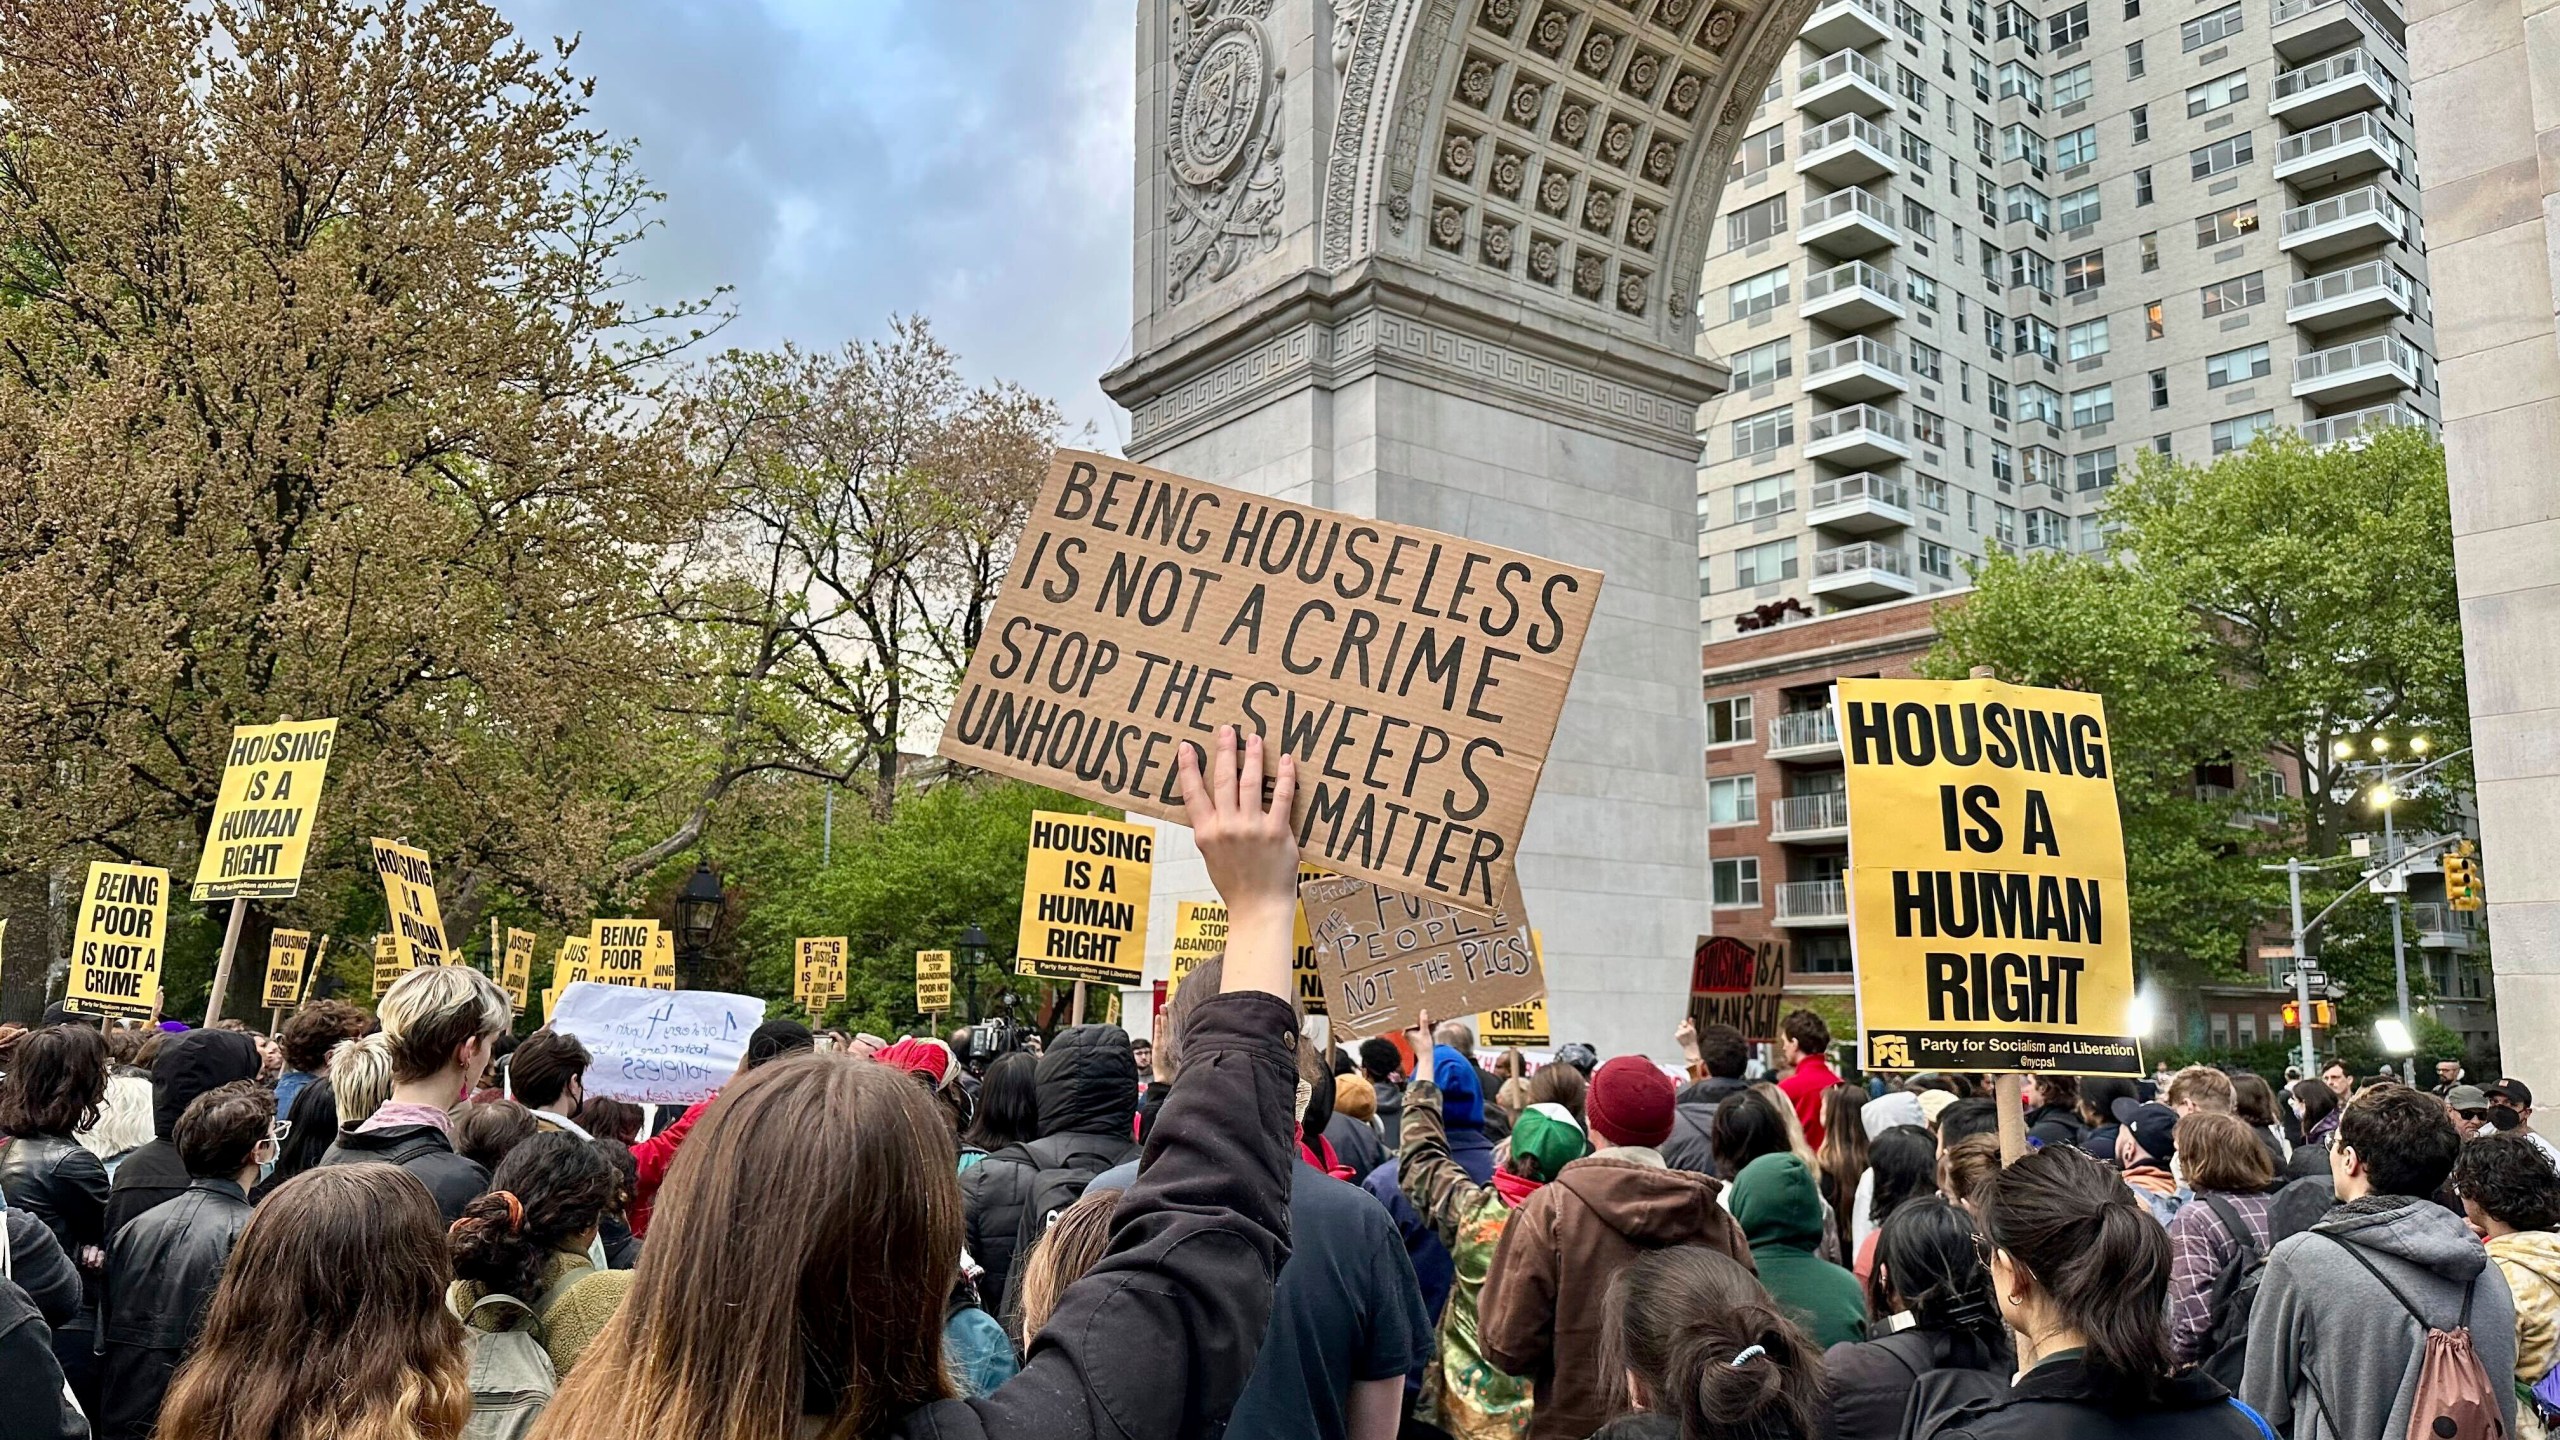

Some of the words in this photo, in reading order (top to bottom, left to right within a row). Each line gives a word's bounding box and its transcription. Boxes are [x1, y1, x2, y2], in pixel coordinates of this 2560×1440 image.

[1054, 461, 1220, 554] BEING
[1221, 501, 1578, 655] HOUSELESS
[1020, 531, 1087, 604] IS
[1095, 551, 1222, 633] NOT
[1219, 583, 1266, 654] A
[1282, 599, 1521, 724] CRIME
[990, 616, 1118, 699] STOP
[1127, 649, 1233, 734] THE
[1234, 681, 1504, 822] SWEEPS
[229, 729, 331, 767] HOUSING
[1846, 700, 2107, 779] HOUSING
[243, 770, 269, 802] IS
[271, 770, 293, 801] A
[956, 683, 1207, 806] UNHOUSED
[1299, 782, 1504, 906] MATTER
[218, 808, 303, 842] HUMAN
[1939, 784, 2004, 854] IS
[2022, 789, 2061, 858] A
[1032, 820, 1152, 864] HOUSING
[220, 843, 284, 878] RIGHT
[374, 847, 433, 888] HOUSING
[1064, 860, 1092, 890] IS
[1098, 864, 1117, 895] A
[95, 871, 159, 907] BEING
[411, 889, 423, 917] A
[91, 904, 154, 939] POOR
[1038, 893, 1135, 932] HUMAN
[1891, 869, 2102, 946] HUMAN
[272, 933, 308, 950] HOUSING
[399, 911, 443, 951] HUMAN
[600, 926, 648, 947] BEING
[1199, 924, 1229, 938] STOP
[1315, 908, 1346, 945] THE
[1333, 914, 1509, 969] PEOPLE
[81, 941, 98, 966] IS
[101, 943, 143, 970] NOT
[144, 948, 156, 972] A
[281, 952, 290, 966] IS
[290, 952, 295, 967] A
[600, 949, 642, 970] POOR
[1046, 927, 1122, 964] RIGHT
[270, 968, 299, 984] HUMAN
[801, 971, 811, 982] IS
[836, 970, 843, 981] A
[1040, 962, 1056, 971] Party
[1068, 965, 1098, 974] Socialism
[1110, 970, 1140, 980] Liberation
[1695, 940, 1753, 989] HOUSING
[1754, 941, 1771, 987] IS
[1769, 943, 1784, 988] A
[85, 968, 143, 998] CRIME
[270, 984, 295, 999] RIGHT
[919, 983, 936, 993] POOR
[937, 983, 949, 992] NEW
[1343, 969, 1396, 1015] NOT
[1408, 953, 1455, 993] THE
[1924, 952, 2085, 1025] RIGHT
[1491, 1010, 1535, 1030] CRIME
[1741, 993, 1783, 1039] RIGHT
[1873, 1043, 1915, 1068] PSL
[1920, 1037, 1958, 1053] Party
[1962, 1037, 1985, 1051] for
[1989, 1038, 2046, 1053] Socialism
[2048, 1040, 2070, 1054] and
[2073, 1042, 2135, 1057] Liberation
[2020, 1055, 2056, 1069] @nycpsl
